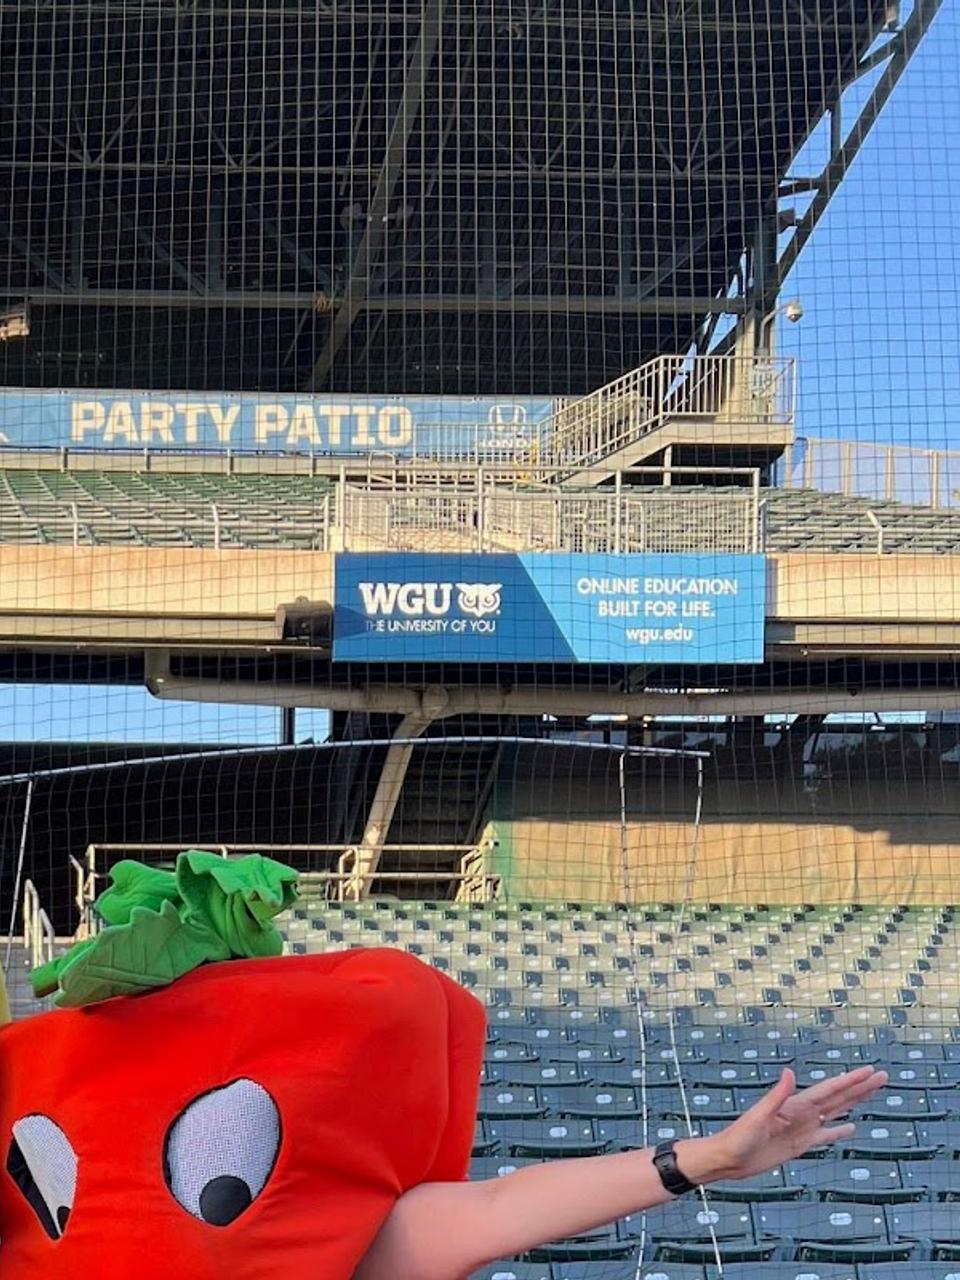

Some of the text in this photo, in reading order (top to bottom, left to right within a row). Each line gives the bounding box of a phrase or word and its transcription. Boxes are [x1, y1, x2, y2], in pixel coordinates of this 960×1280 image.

[71, 400, 414, 446] PARTY PATIO
[577, 577, 738, 596] ONLINE EDUCATION
[358, 582, 453, 615] WGU
[598, 600, 715, 617] BUILT FOR LIFE.
[366, 619, 496, 632] THE UNIVERSITY OF YOU
[626, 622, 693, 644] wgu.edu
